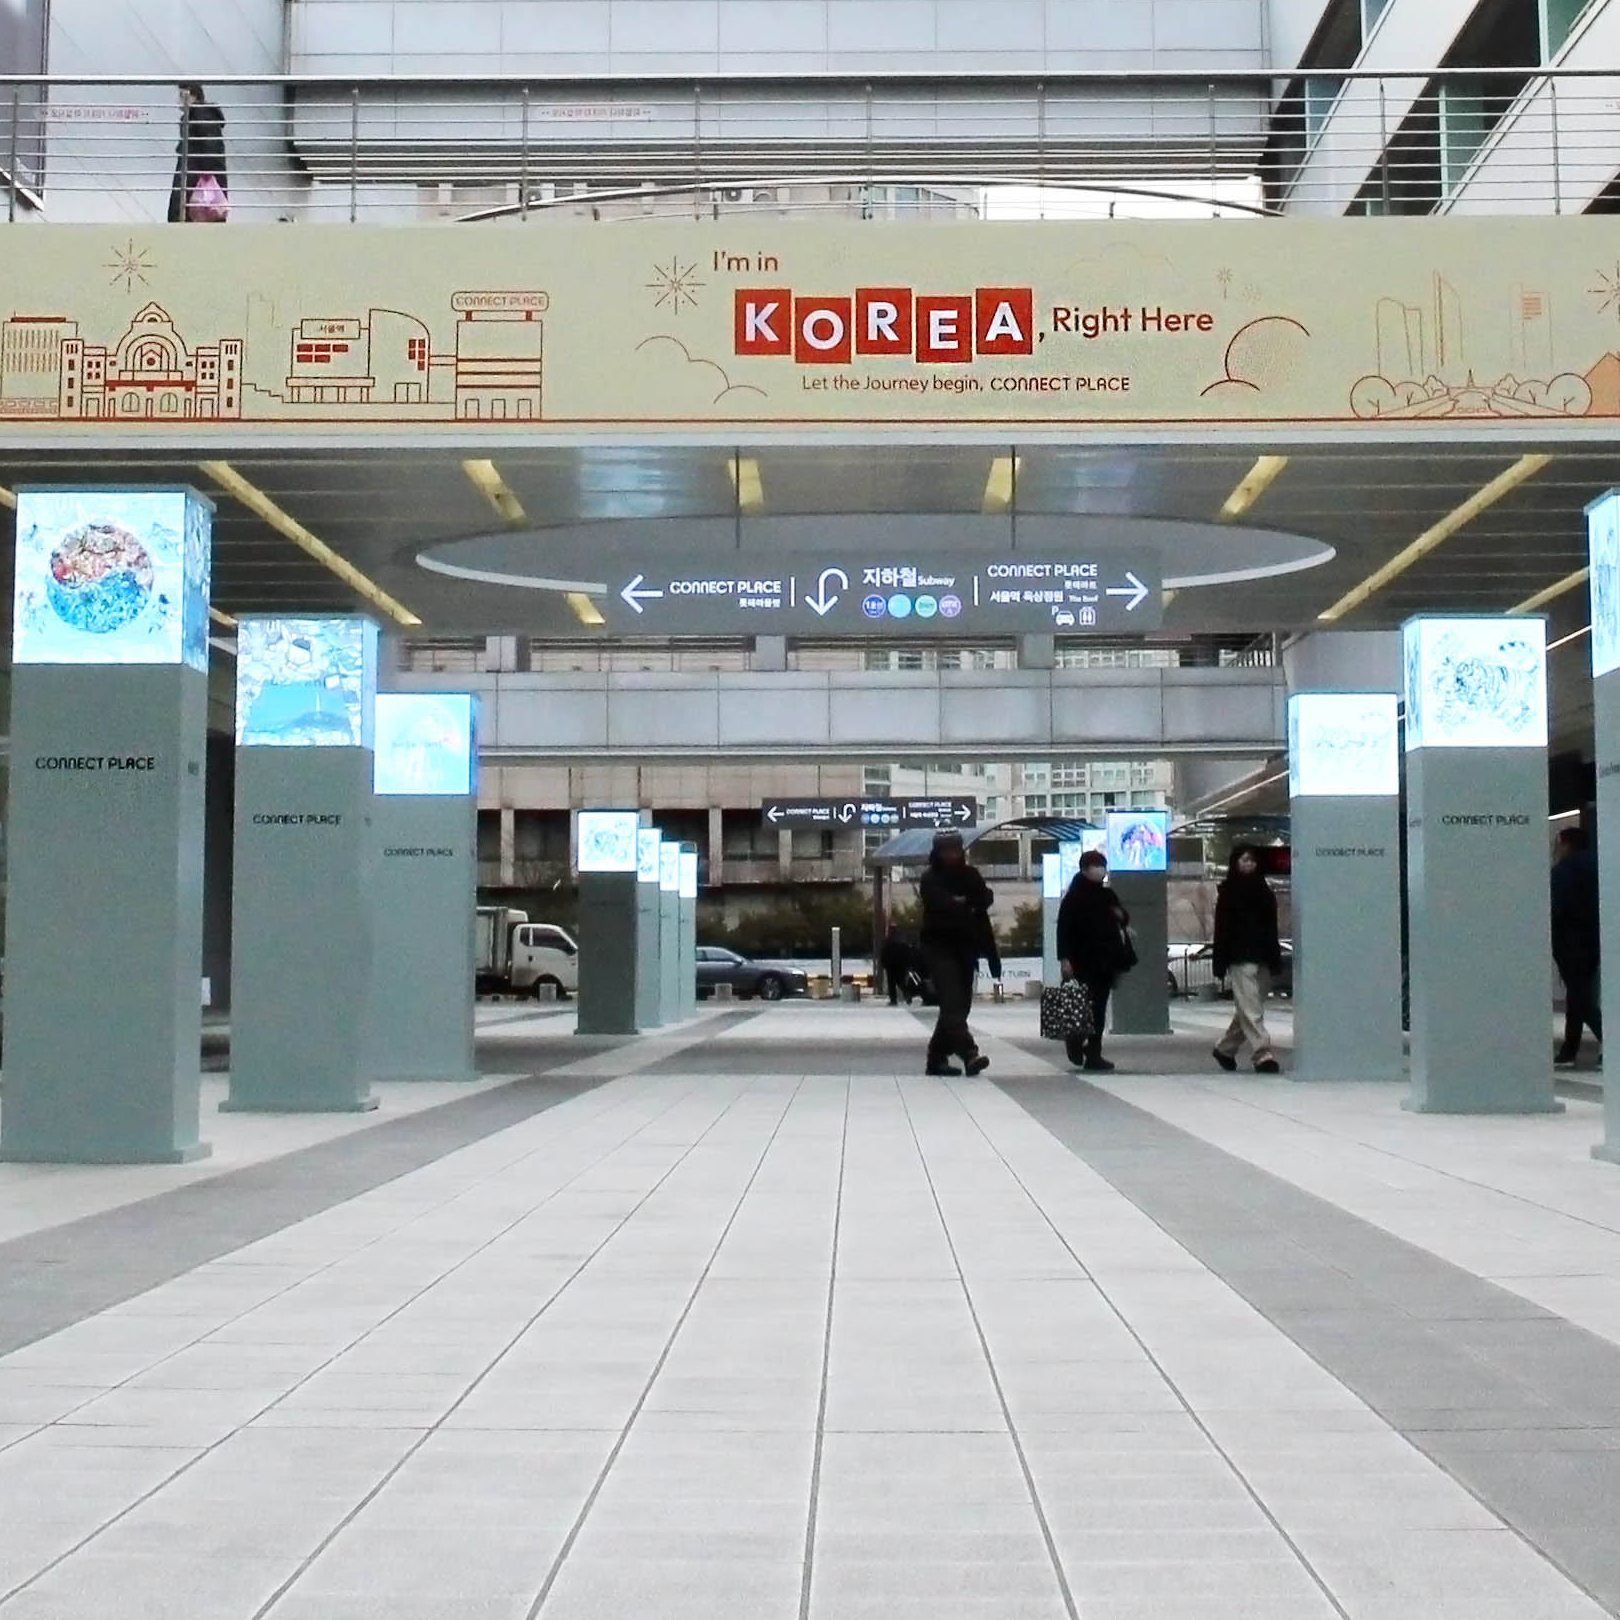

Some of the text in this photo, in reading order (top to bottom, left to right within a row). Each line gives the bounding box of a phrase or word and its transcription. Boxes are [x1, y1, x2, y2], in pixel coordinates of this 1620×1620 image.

[712, 250, 779, 273] I'm in
[1052, 306, 1135, 335] Right
[1141, 306, 1214, 334] Here
[802, 373, 1130, 394] Let the Journey begin, CONNECT PLACE
[863, 568, 956, 587] 지하철 Subway
[987, 564, 1097, 577] CONNECT PLACE
[669, 580, 781, 594] CONNECT PLACE
[990, 591, 1020, 603] 서울역
[36, 757, 156, 770] CONNECT PLACE
[1442, 814, 1493, 826] CONNECT
